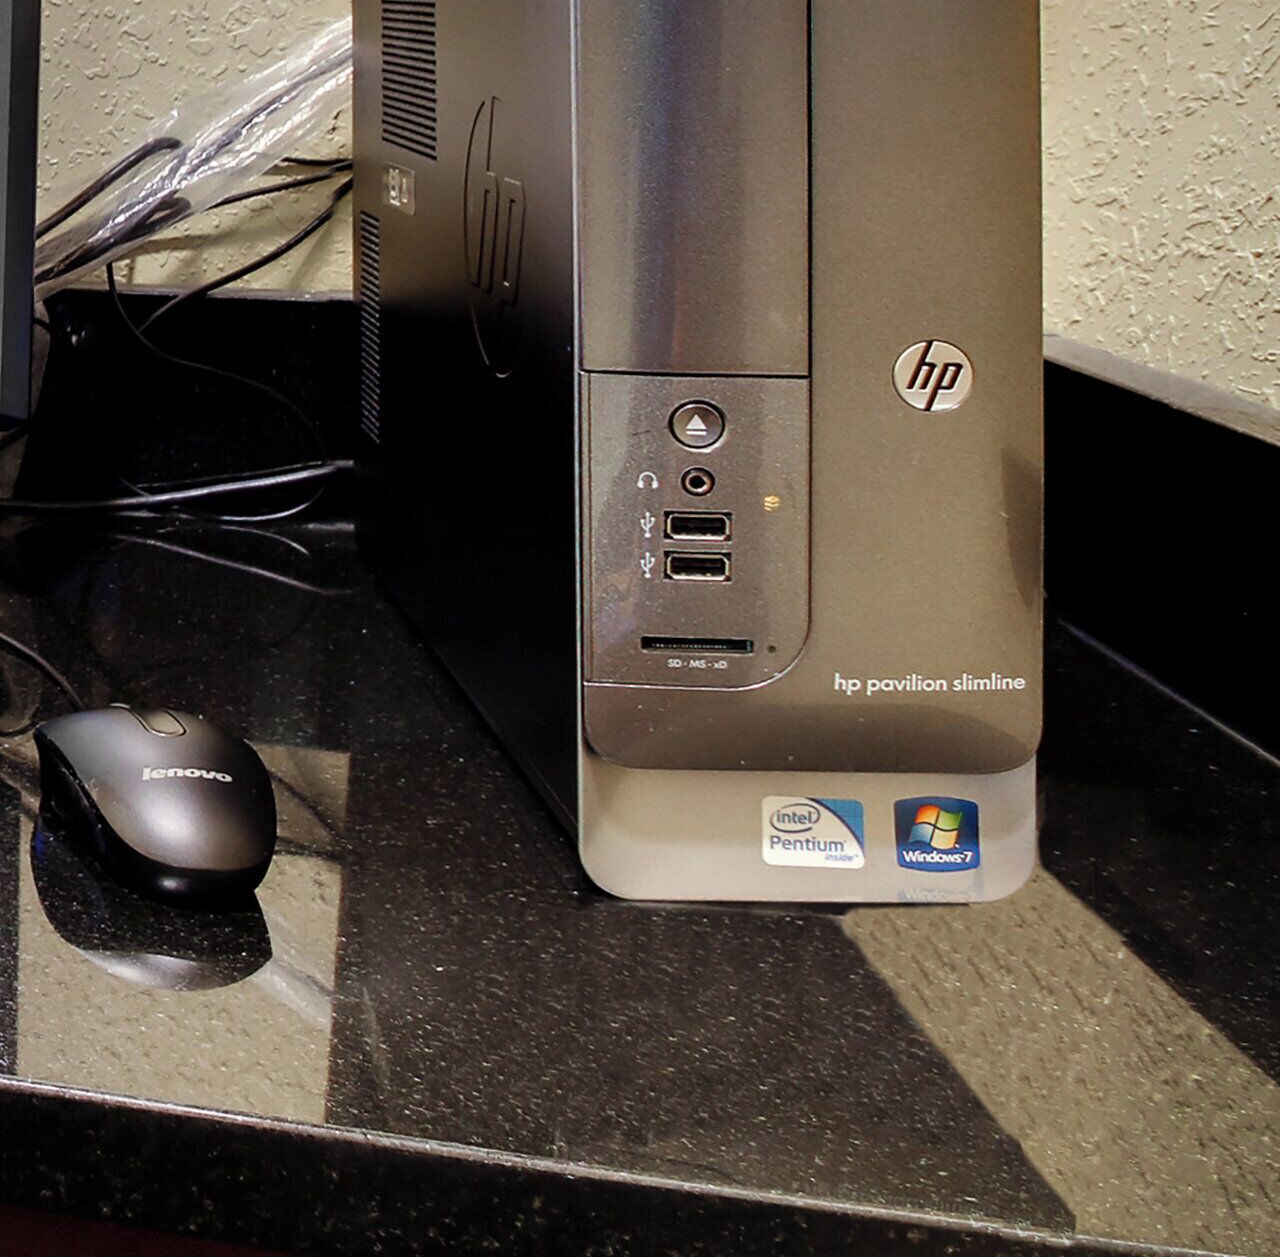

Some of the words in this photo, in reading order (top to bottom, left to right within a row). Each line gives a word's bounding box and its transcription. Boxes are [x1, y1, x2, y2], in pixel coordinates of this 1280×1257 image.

[904, 340, 964, 412] hp
[666, 658, 682, 668] SD
[688, 659, 707, 669] MS
[834, 672, 861, 695] hp
[866, 673, 947, 696] pavilion
[952, 672, 1026, 691] slimline
[142, 767, 233, 783] lenovo
[776, 810, 813, 825] intel
[769, 835, 845, 853] Pentium
[824, 854, 854, 862] inside
[902, 850, 962, 863] Windows
[963, 851, 974, 863] 7
